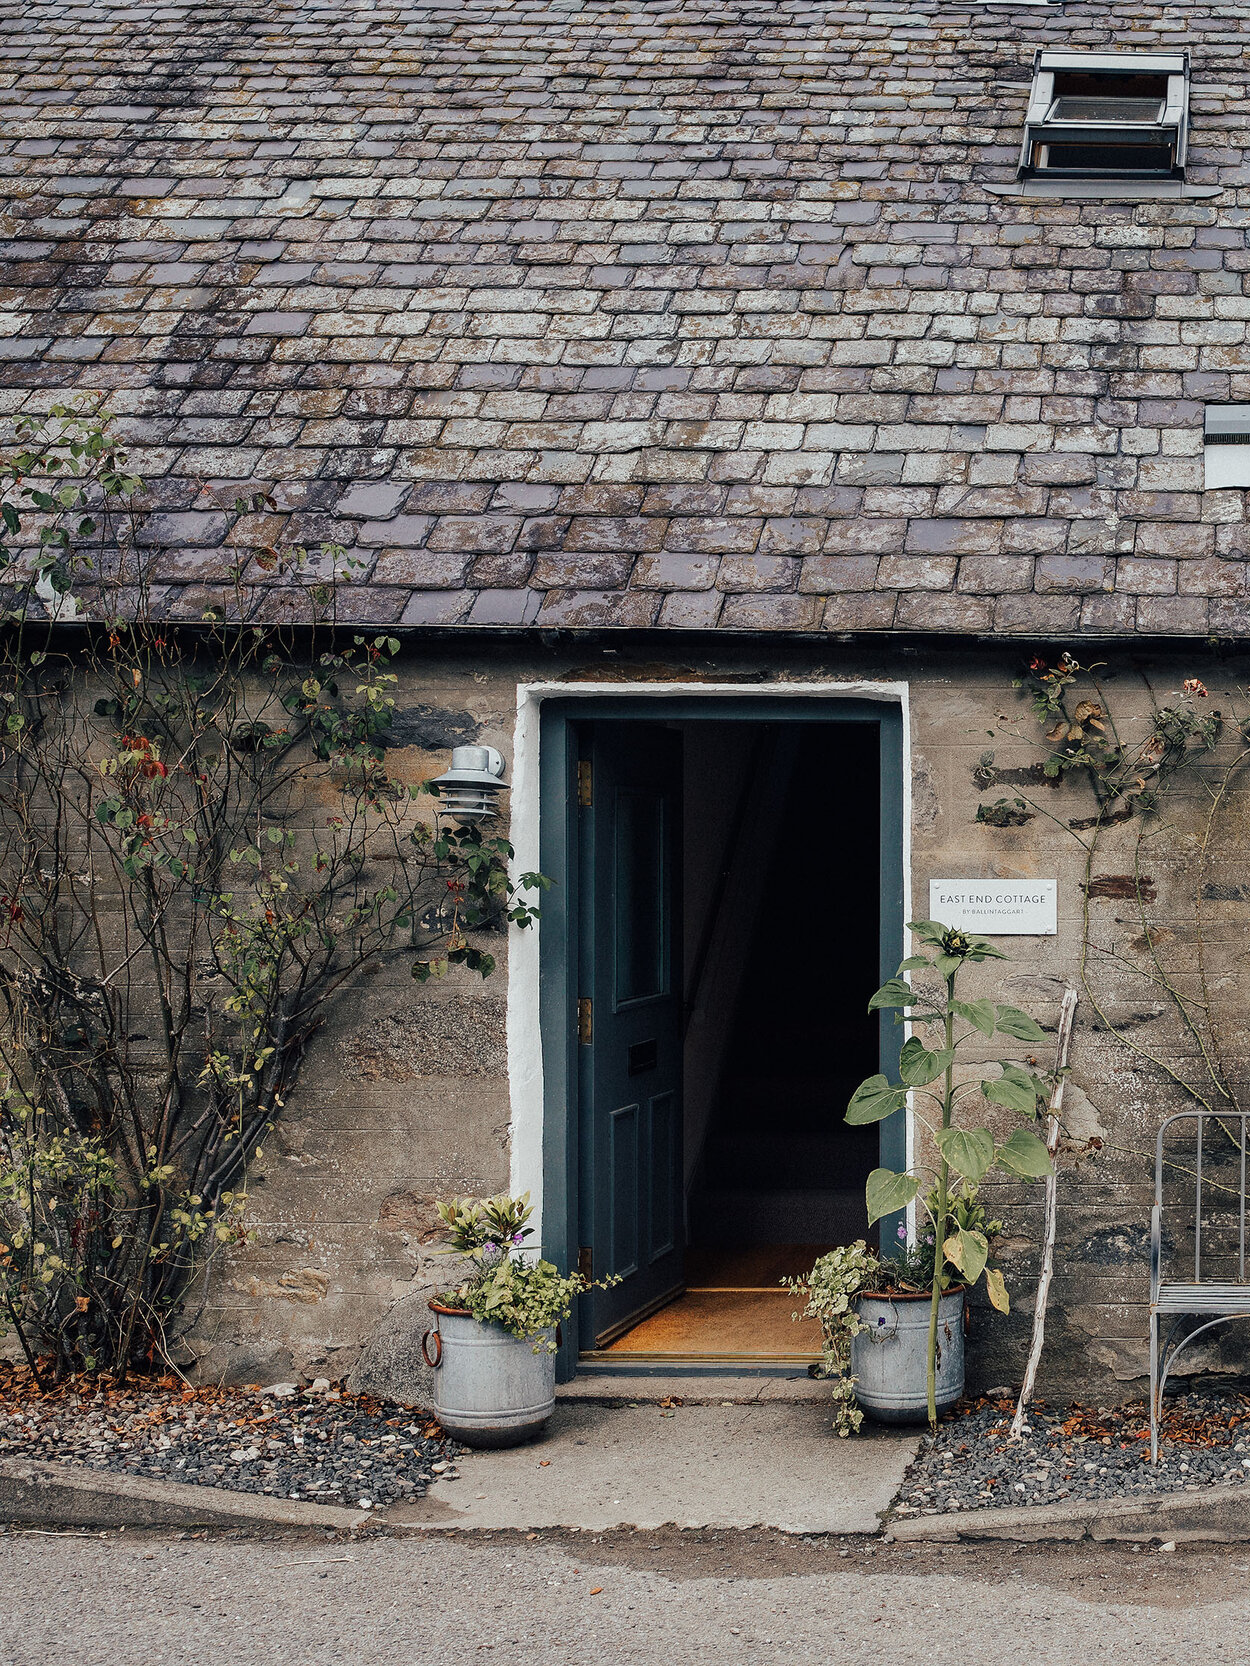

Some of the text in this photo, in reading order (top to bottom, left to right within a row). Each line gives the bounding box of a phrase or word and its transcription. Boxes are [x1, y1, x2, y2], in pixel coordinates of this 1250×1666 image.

[940, 894, 1046, 904] EAST END COTTAGE
